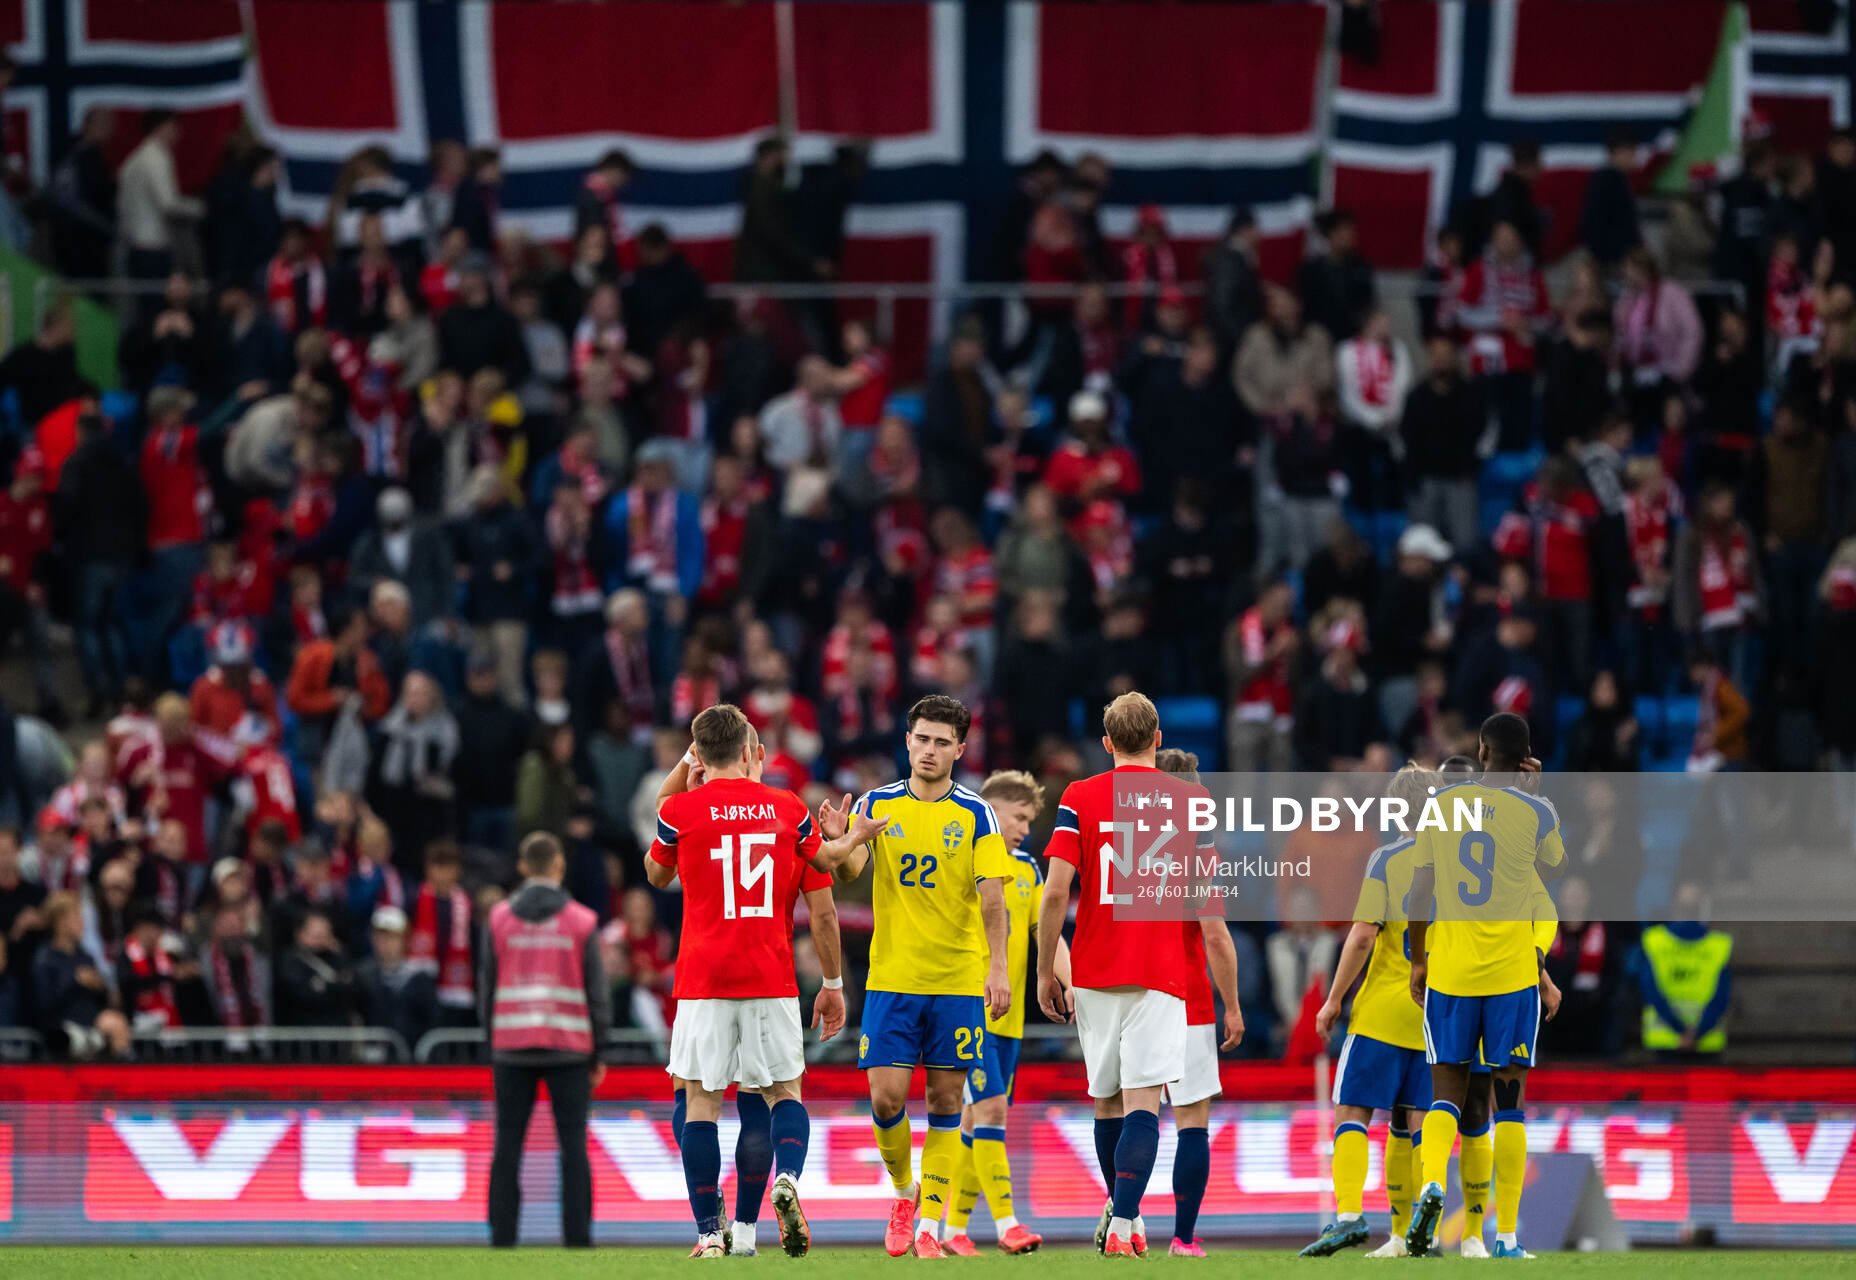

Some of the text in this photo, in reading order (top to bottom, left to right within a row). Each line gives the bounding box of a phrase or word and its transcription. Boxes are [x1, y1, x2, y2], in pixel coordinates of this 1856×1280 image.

[709, 803, 777, 821] BJØRKAN
[710, 833, 776, 920] 15
[899, 853, 938, 889] 22
[1099, 821, 1179, 906] 24
[1457, 830, 1496, 907] 9
[107, 1115, 468, 1200] VG
[923, 1173, 950, 1185] SVERIGE
